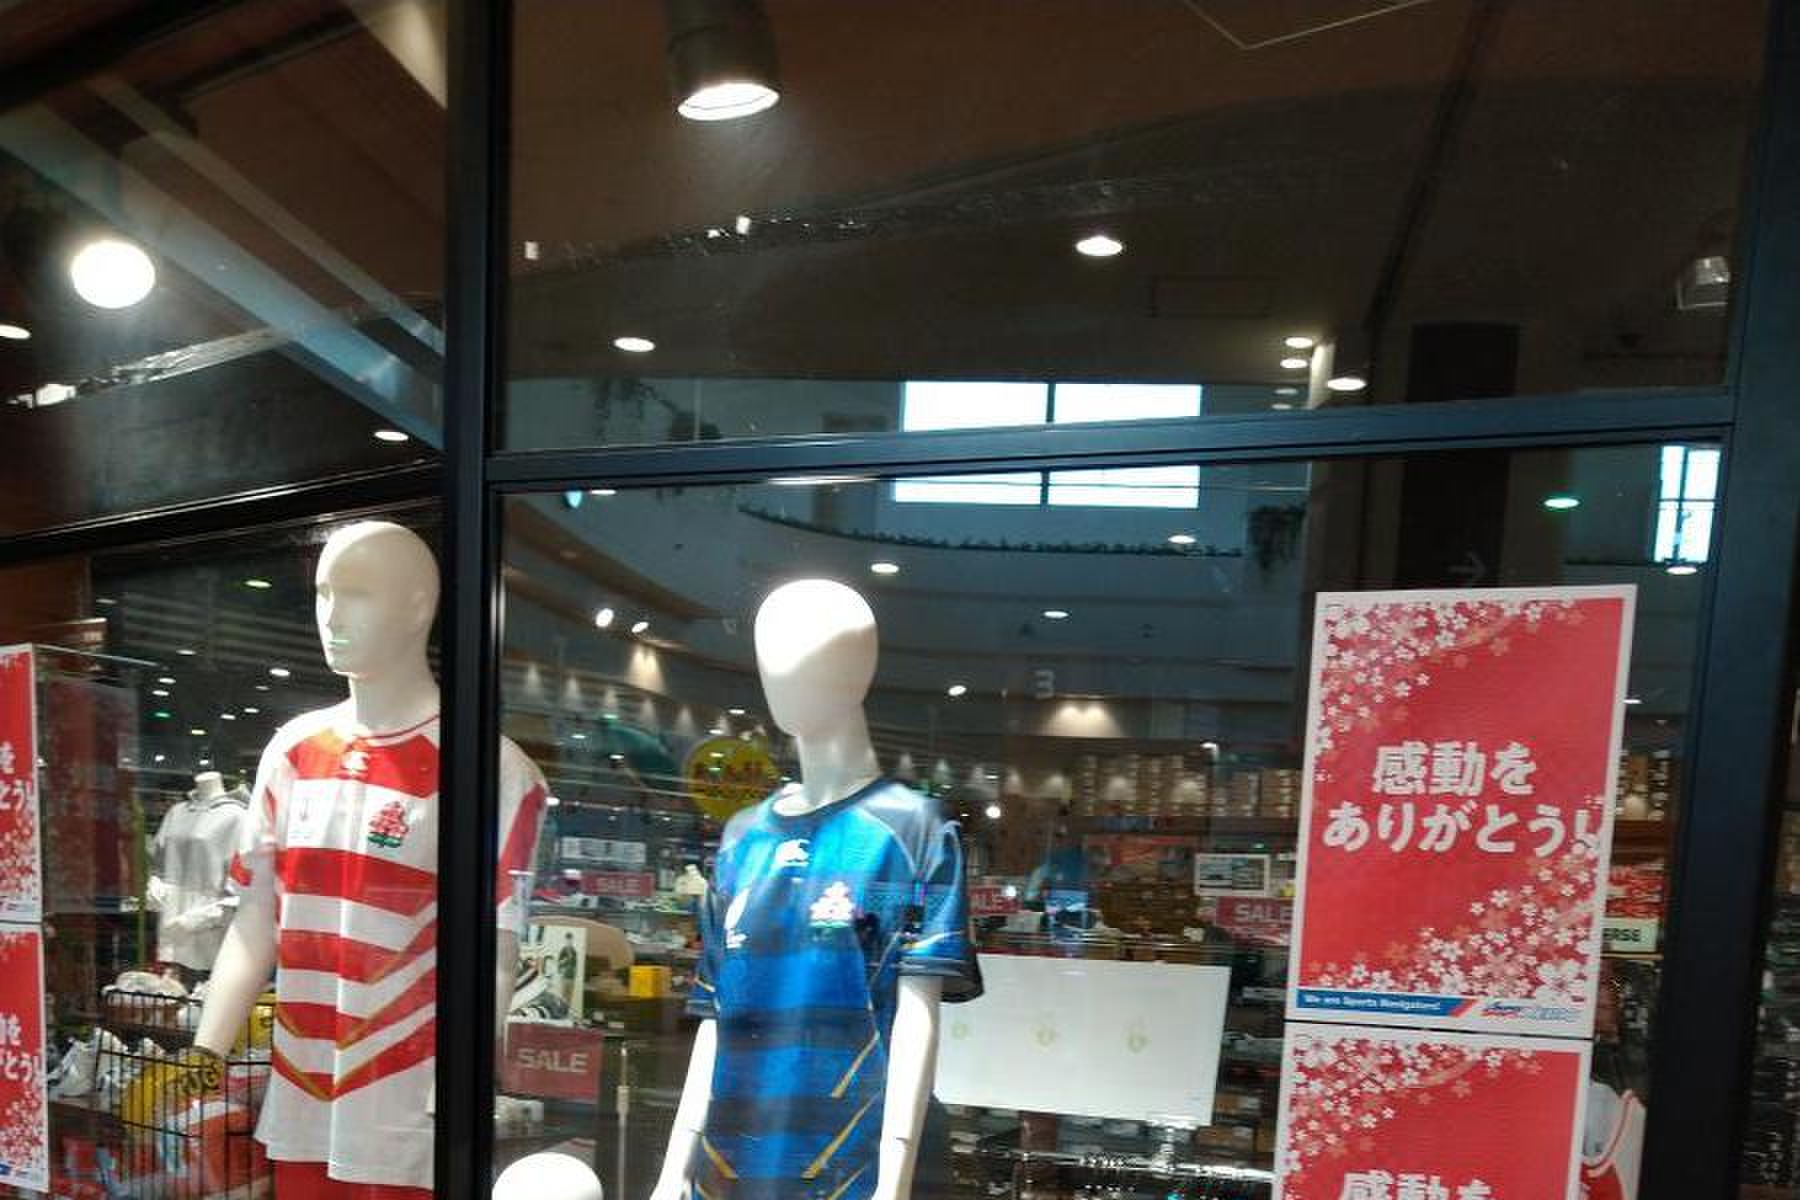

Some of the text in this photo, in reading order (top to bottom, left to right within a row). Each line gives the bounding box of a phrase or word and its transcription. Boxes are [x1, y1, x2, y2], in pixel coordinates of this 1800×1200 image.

[1371, 740, 1537, 796] 感動を
[516, 1047, 589, 1075] SALE
